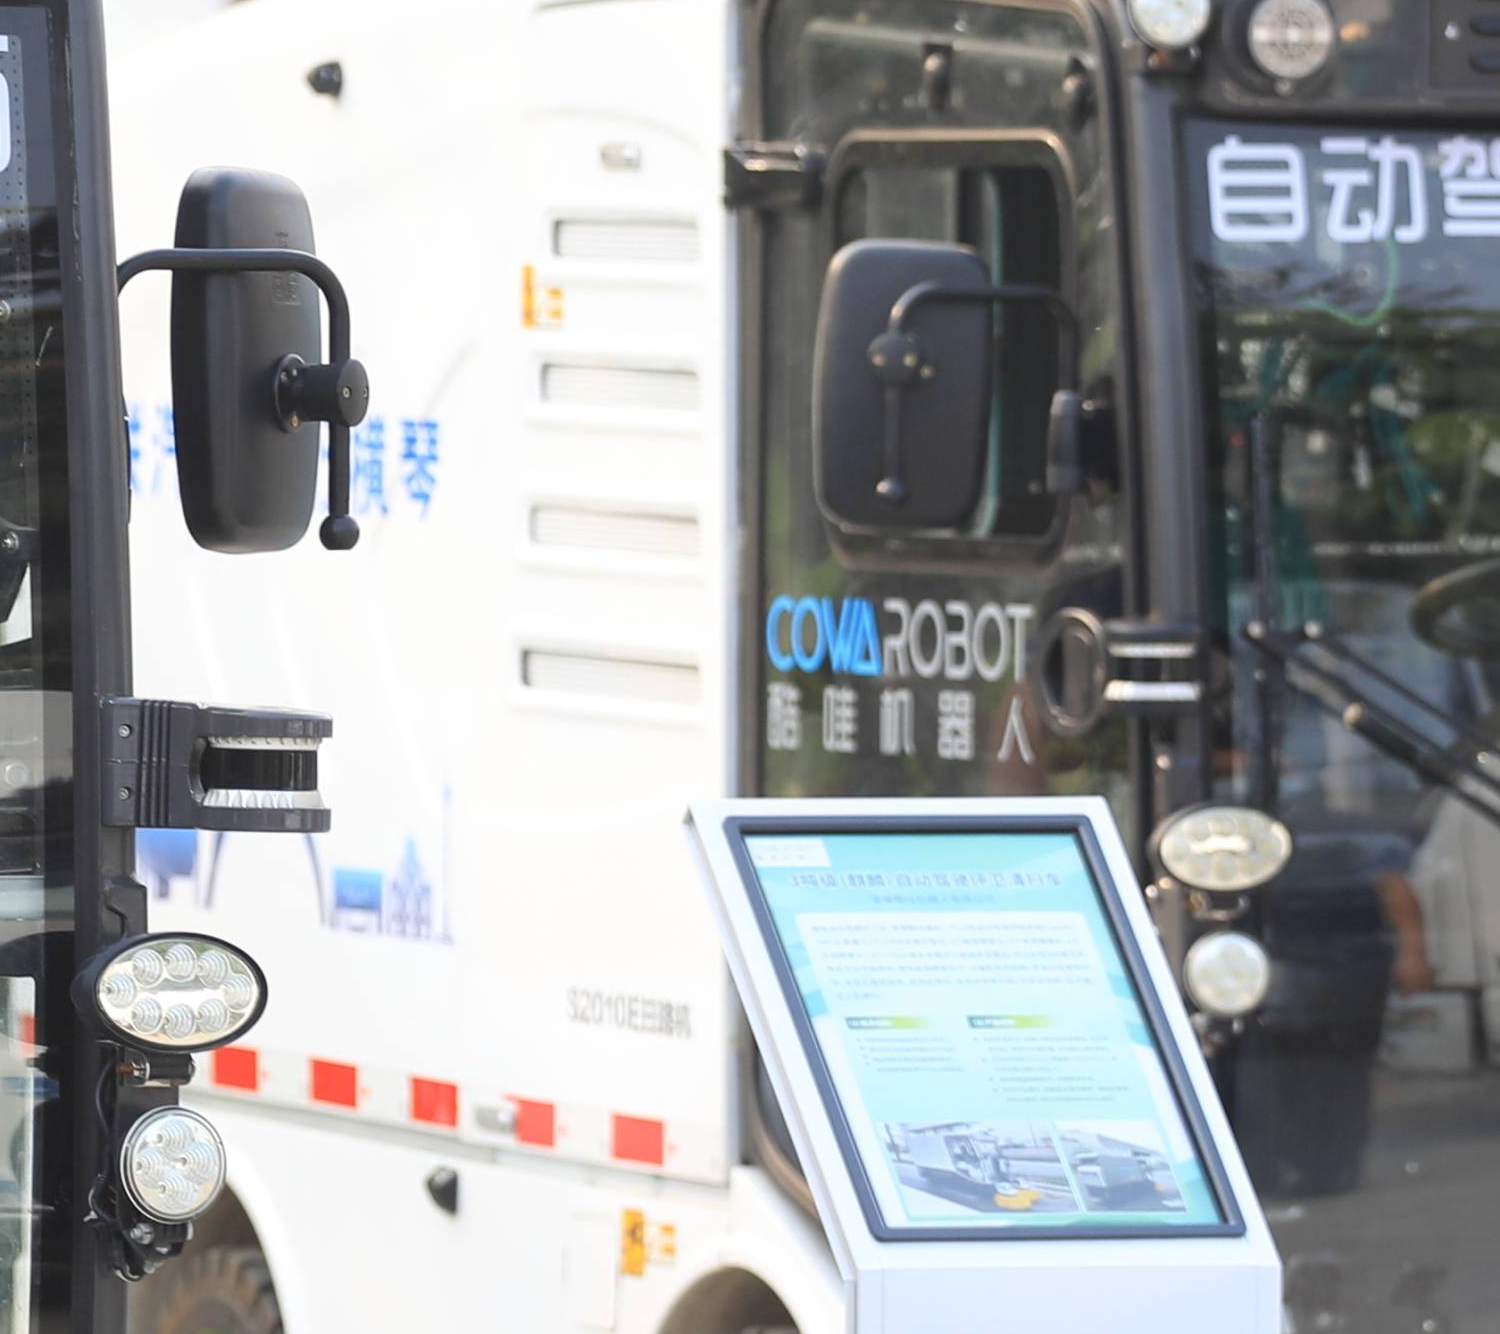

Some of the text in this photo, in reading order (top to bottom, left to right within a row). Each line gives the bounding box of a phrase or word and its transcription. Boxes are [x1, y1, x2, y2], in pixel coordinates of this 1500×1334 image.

[766, 681, 1036, 765] 酷哇机器人
